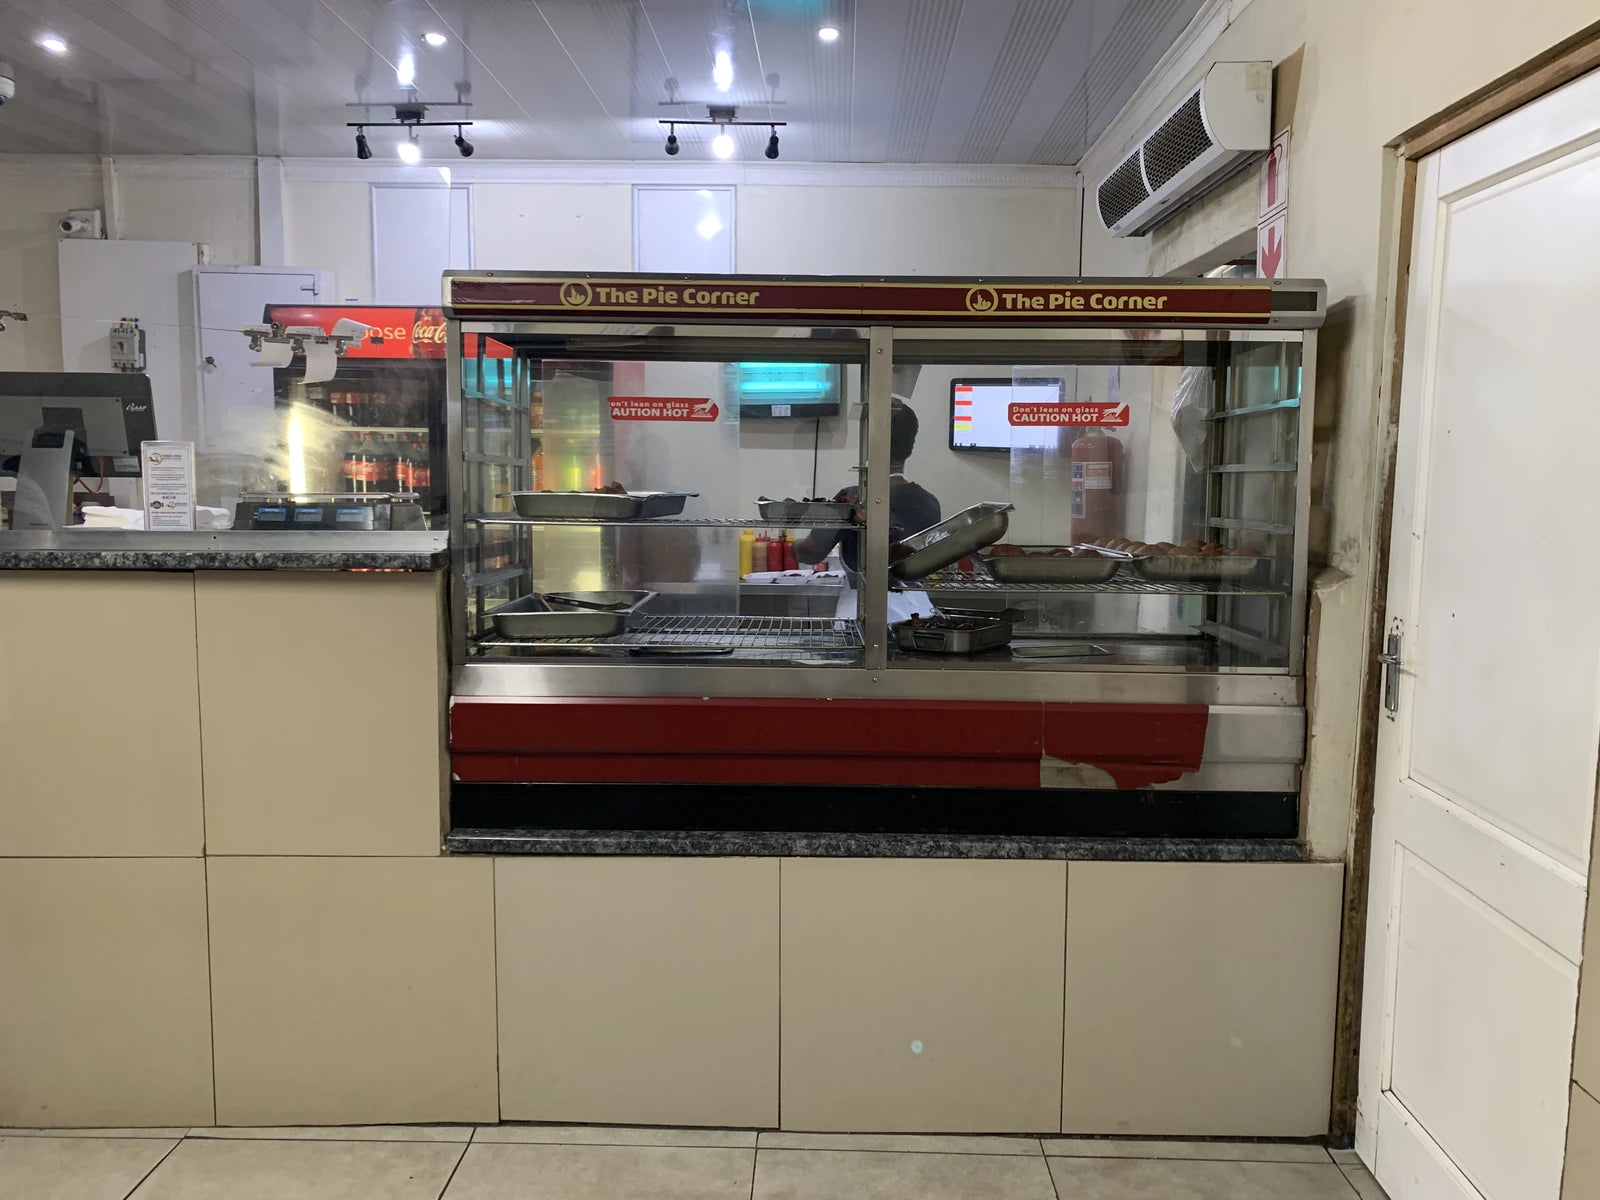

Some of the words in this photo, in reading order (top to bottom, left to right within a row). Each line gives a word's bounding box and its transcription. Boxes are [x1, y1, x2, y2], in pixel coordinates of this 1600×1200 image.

[596, 287, 639, 304] The
[643, 285, 678, 304] Pie
[682, 288, 760, 305] Corner
[1002, 293, 1045, 309] The
[1049, 291, 1085, 309] Pie
[1089, 293, 1168, 309] Corner
[666, 401, 689, 409] glass
[612, 408, 660, 417] AUTION
[663, 408, 690, 417] HOT
[1075, 406, 1099, 414] glass
[1012, 413, 1069, 422] CAUTION
[1072, 413, 1099, 422] HOT
